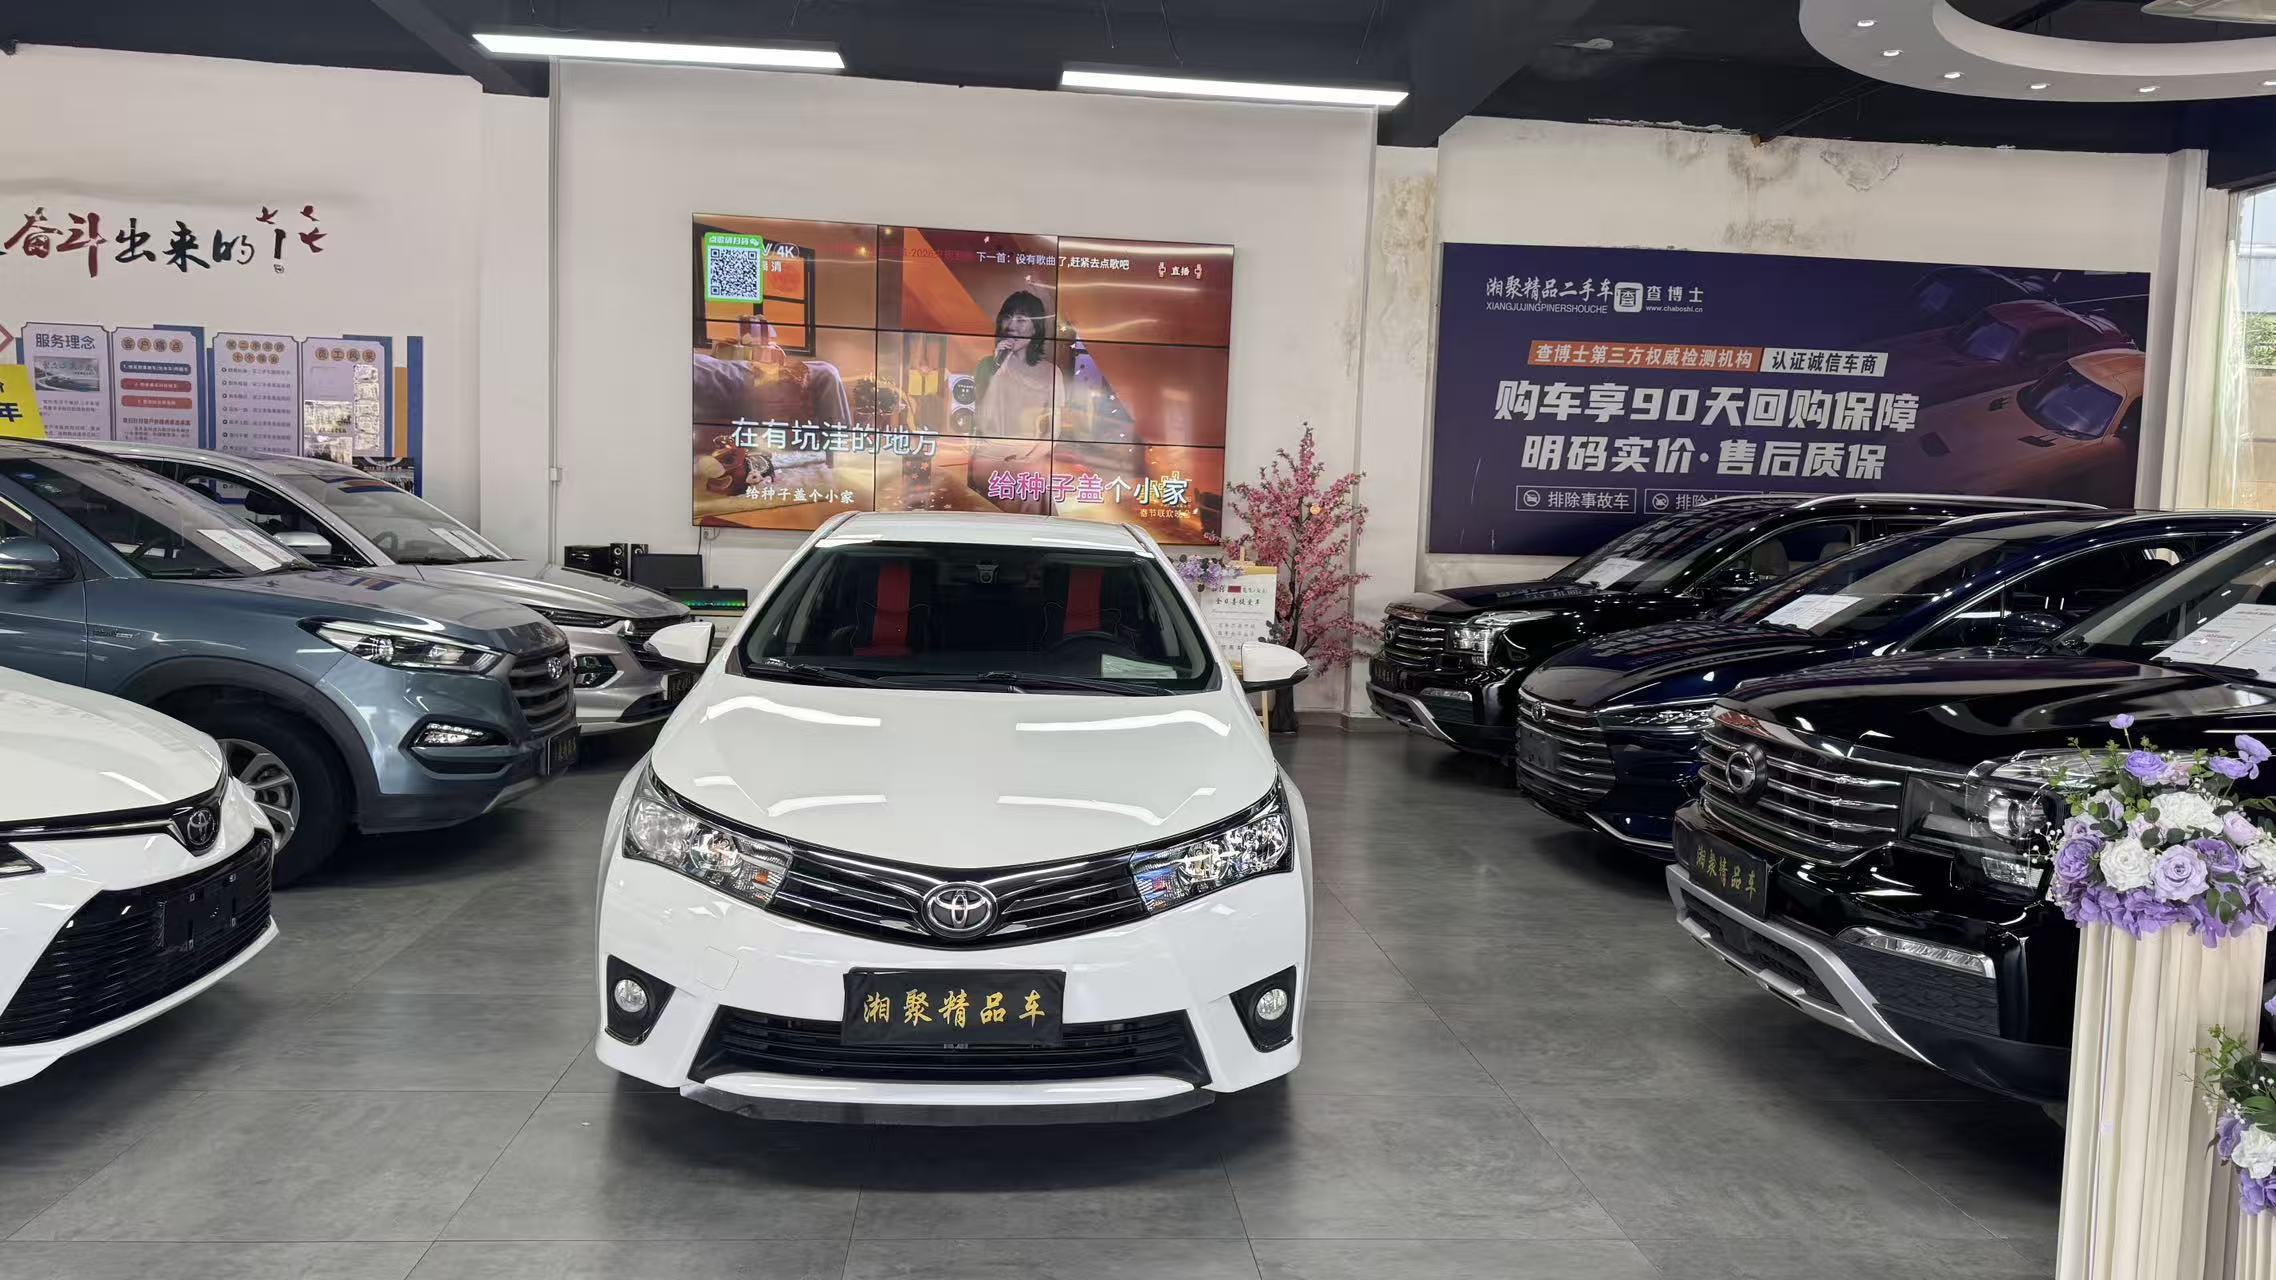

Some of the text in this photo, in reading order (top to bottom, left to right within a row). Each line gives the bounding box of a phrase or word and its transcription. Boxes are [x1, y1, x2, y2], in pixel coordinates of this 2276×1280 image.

[1486, 275, 1614, 302] 湘聚精品二手车
[1646, 286, 1704, 303] 查博士
[1486, 302, 1608, 314] XIANGJUJINGPINERSHOUCHE
[35, 333, 96, 350] 服务理念
[1535, 344, 1877, 373] 查博士第三方权威检测机构 认证诚信车商
[1494, 380, 1919, 433] 购车享90天回购保障
[731, 417, 939, 457] 在有坑洼的地方
[1521, 435, 1887, 480] 明码实价·售后质保
[745, 486, 855, 503] 给种子盖个小家
[988, 471, 1189, 506] 给种子盖个小家
[1547, 491, 1630, 510] 排除事故车
[1696, 845, 1757, 901] 湘聚精品车
[863, 988, 1046, 1029] 湘聚精品车
